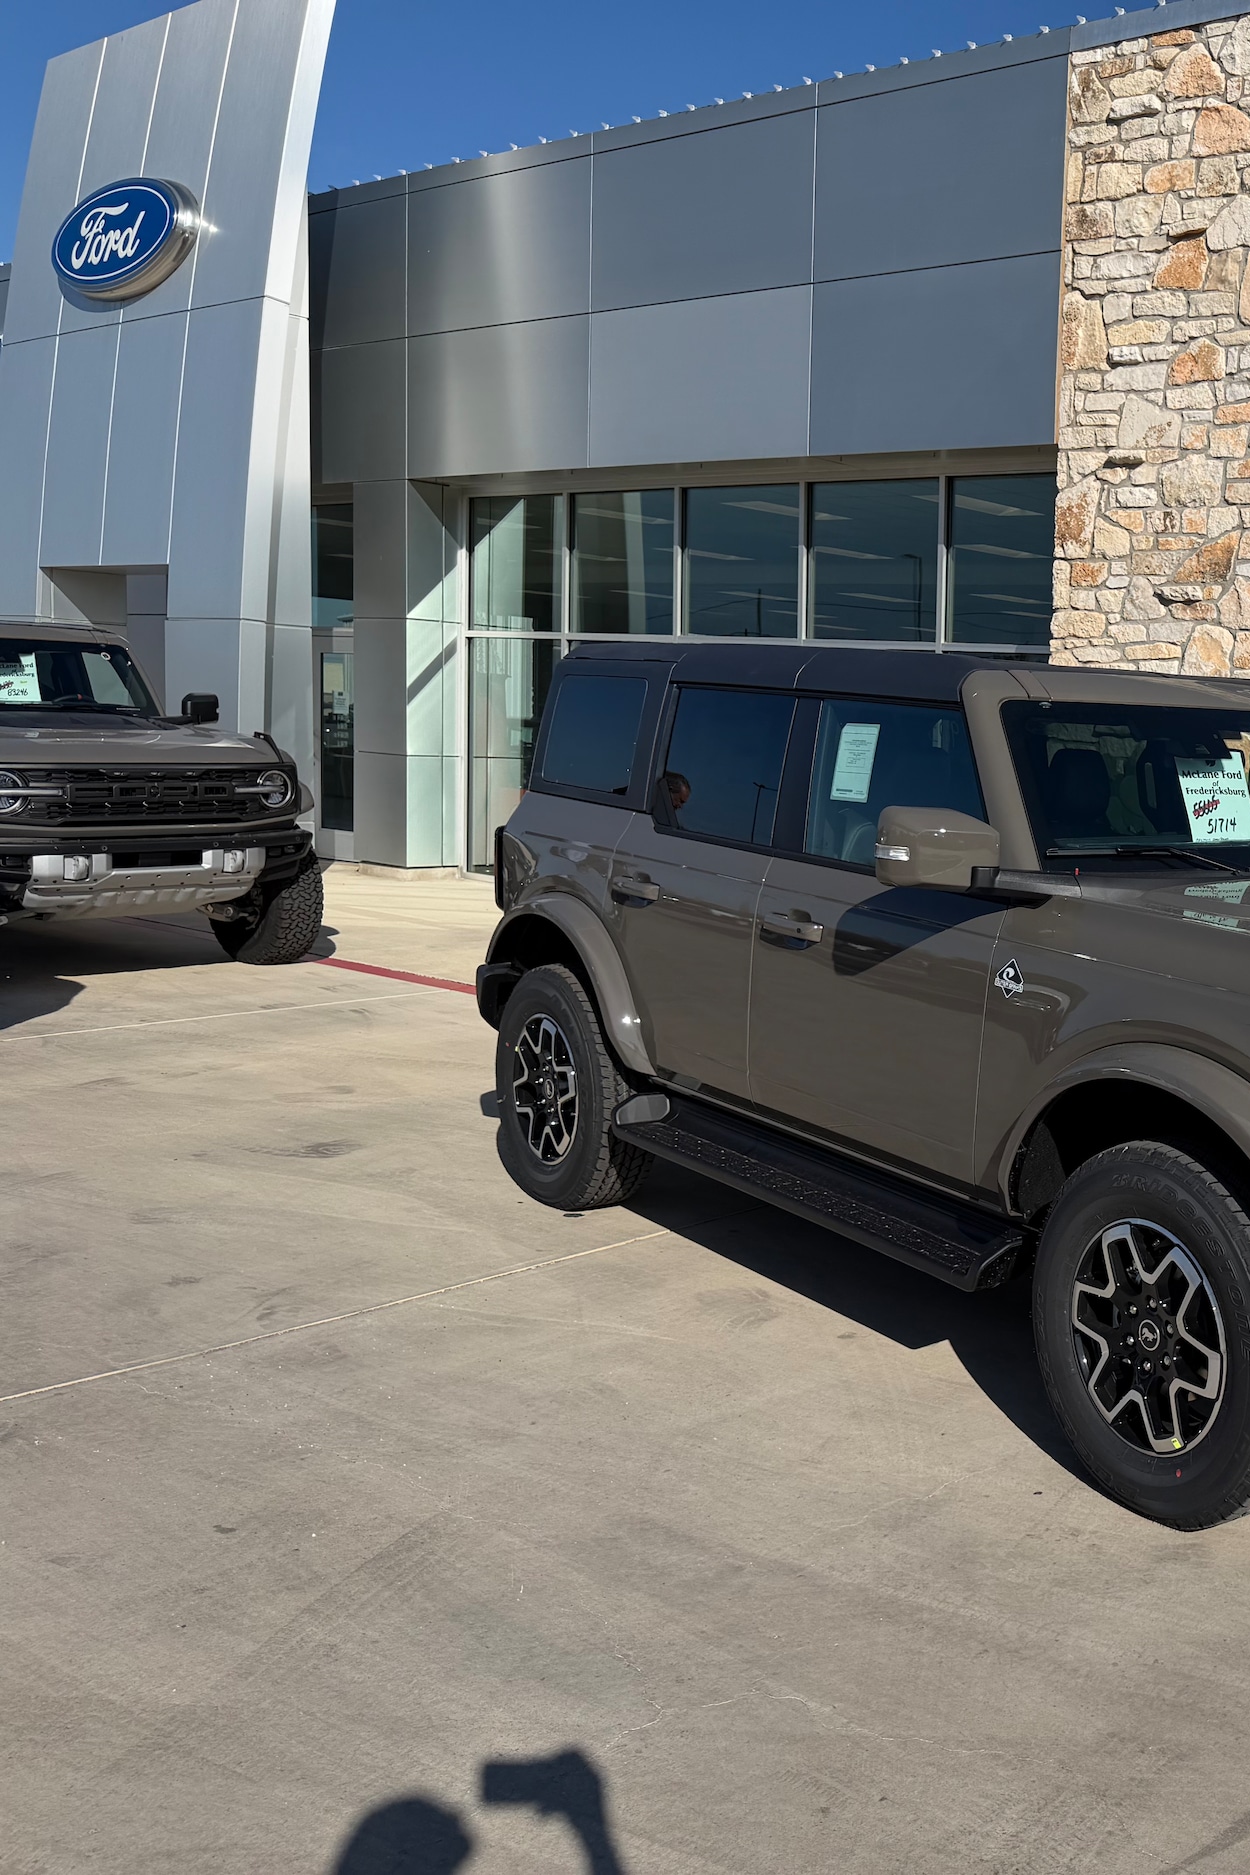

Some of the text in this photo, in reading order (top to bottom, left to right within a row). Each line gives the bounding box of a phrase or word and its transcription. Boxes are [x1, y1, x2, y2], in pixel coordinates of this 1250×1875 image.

[71, 202, 146, 270] Ford
[1182, 770, 1243, 780] McLane Ford
[1185, 785, 1247, 798] Fredericksburg
[1206, 816, 1237, 835] 51714
